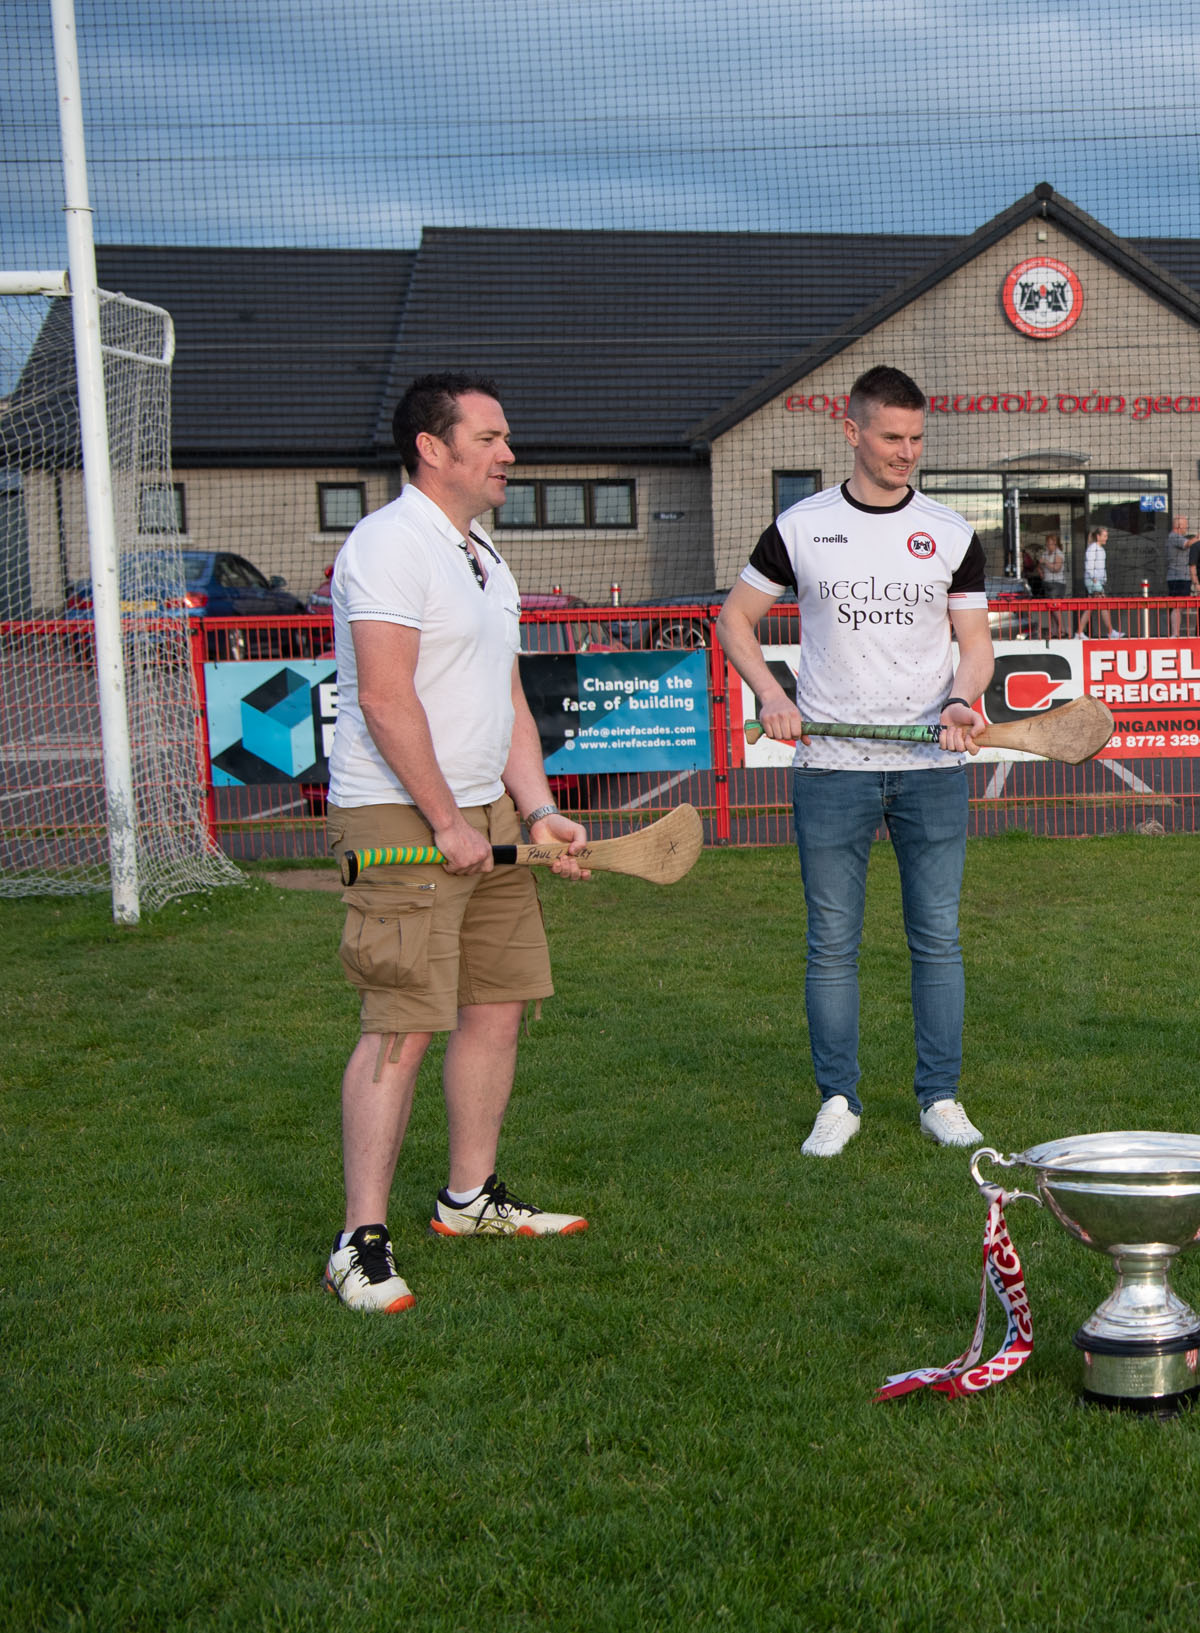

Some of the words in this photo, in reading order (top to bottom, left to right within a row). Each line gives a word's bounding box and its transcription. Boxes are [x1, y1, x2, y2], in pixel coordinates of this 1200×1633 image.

[837, 603, 914, 631] Sports
[583, 677, 660, 694] Changing
[666, 676, 693, 689] the
[562, 697, 597, 712] face
[603, 696, 622, 710] of
[629, 695, 695, 711] building
[578, 725, 696, 738] info@eirefacades.com
[580, 738, 697, 750] www.eirefacades.com
[1126, 734, 1166, 747] 8772
